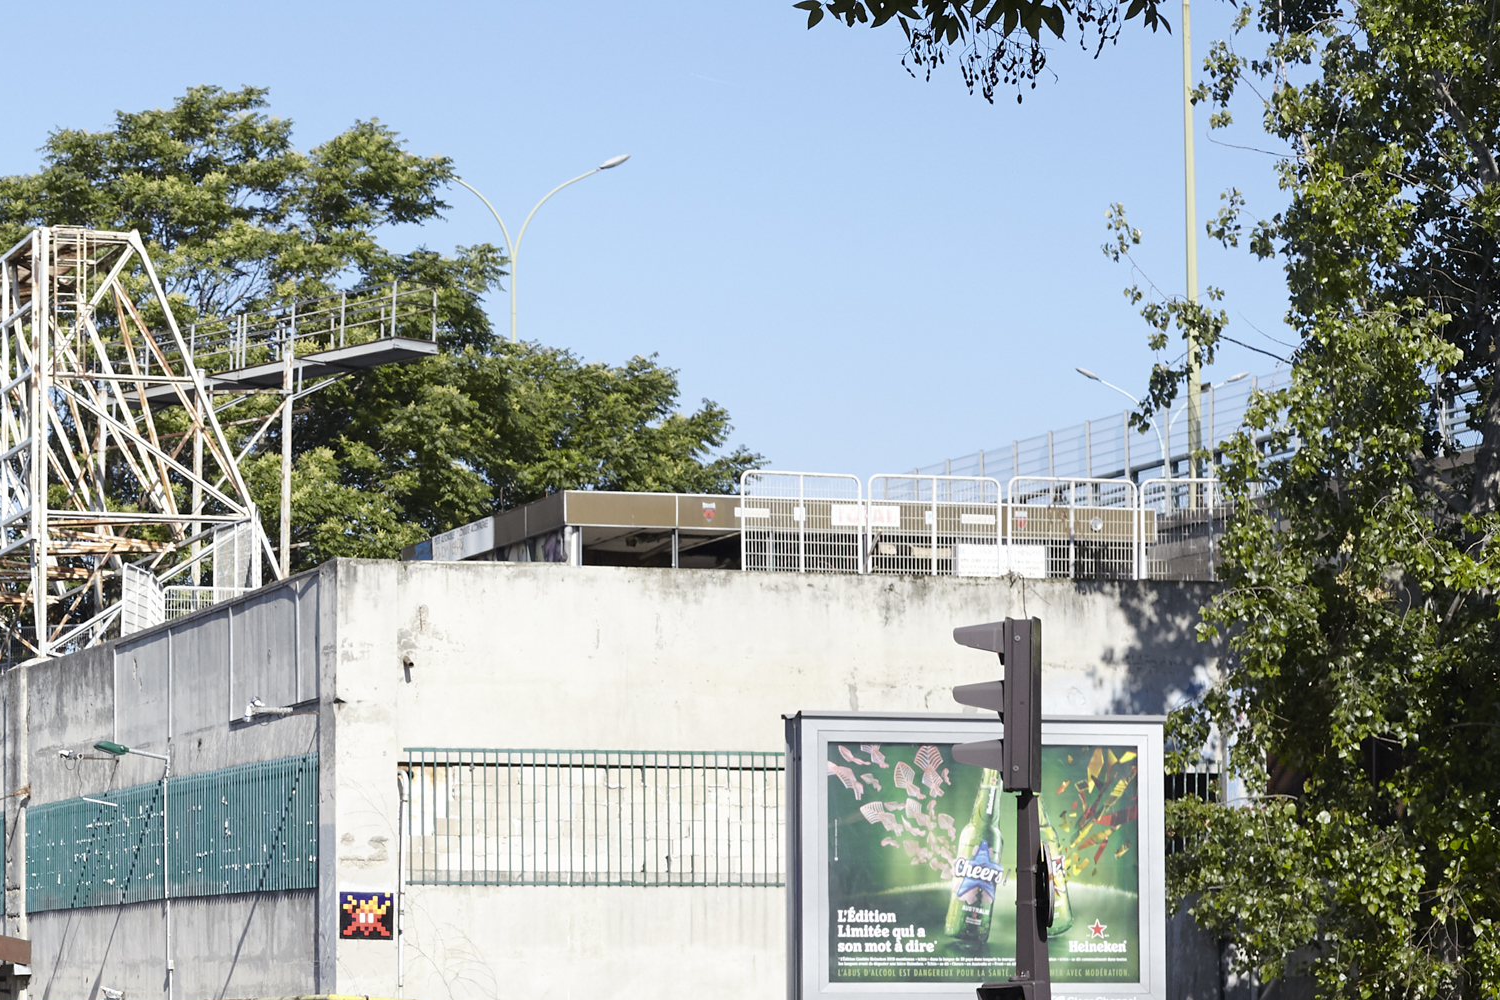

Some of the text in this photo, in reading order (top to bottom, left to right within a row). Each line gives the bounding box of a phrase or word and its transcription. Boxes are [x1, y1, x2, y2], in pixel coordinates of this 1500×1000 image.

[837, 906, 897, 923] L'Édition
[837, 924, 926, 941] Limitée qui a
[837, 942, 863, 953] son
[864, 940, 892, 953] mot
[894, 939, 903, 953] à
[837, 968, 861, 977] L'ABUS
[863, 968, 896, 977] D'ALCOOL
[898, 968, 911, 977] EST
[913, 968, 954, 977] DANGEREUX
[956, 968, 975, 977] POUR
[977, 968, 986, 977] LA
[1066, 968, 1082, 977] AVEC
